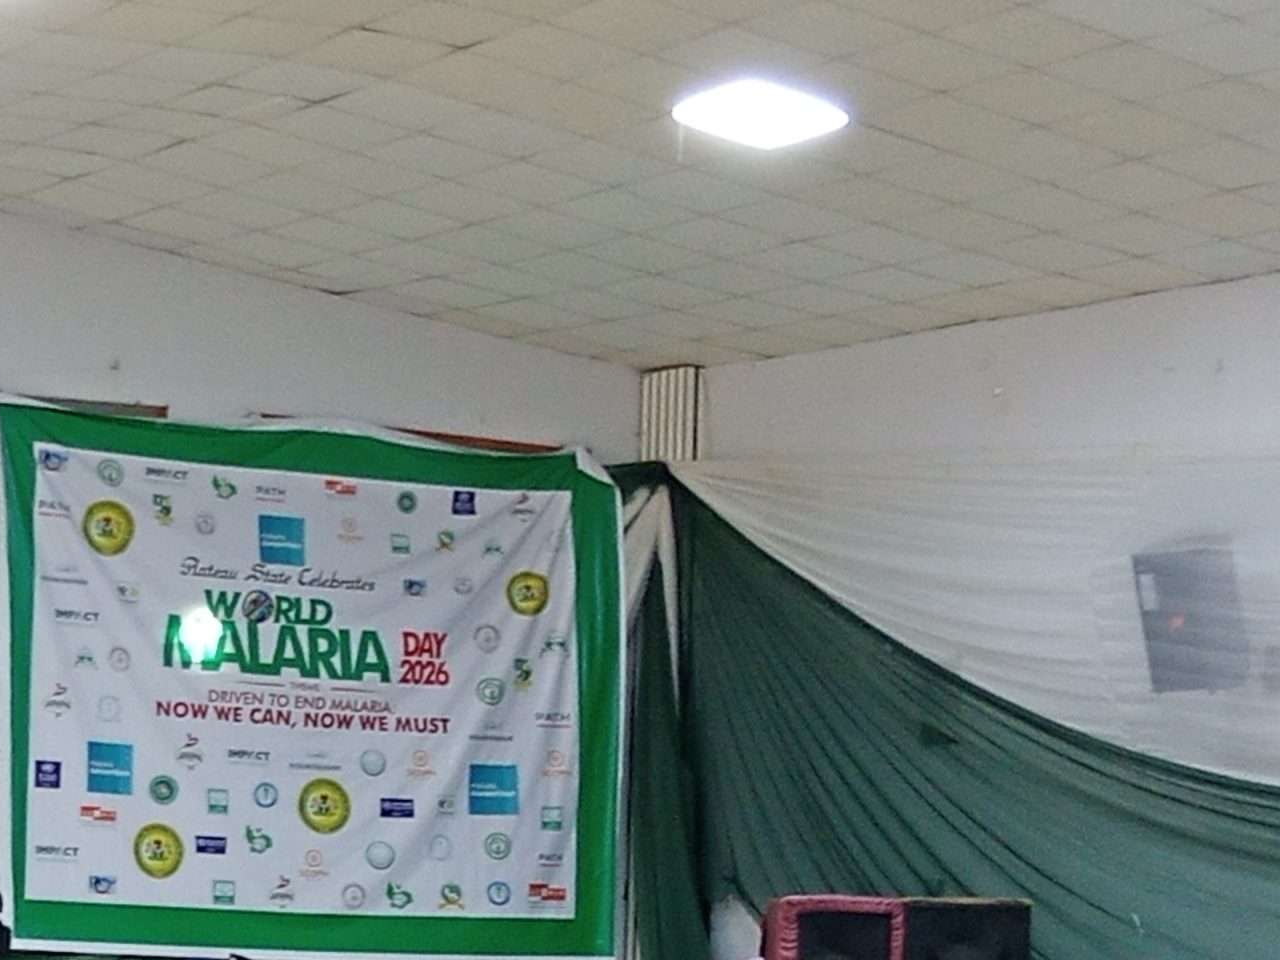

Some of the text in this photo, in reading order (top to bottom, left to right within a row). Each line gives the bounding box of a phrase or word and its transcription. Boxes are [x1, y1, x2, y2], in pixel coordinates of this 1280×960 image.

[402, 631, 448, 659] DAY
[398, 659, 450, 686] 2026
[208, 689, 265, 705] DRIVEN
[268, 692, 290, 708] TO
[294, 694, 326, 710] END
[156, 700, 451, 734] NOW WE CAN, NOW WE MUST
